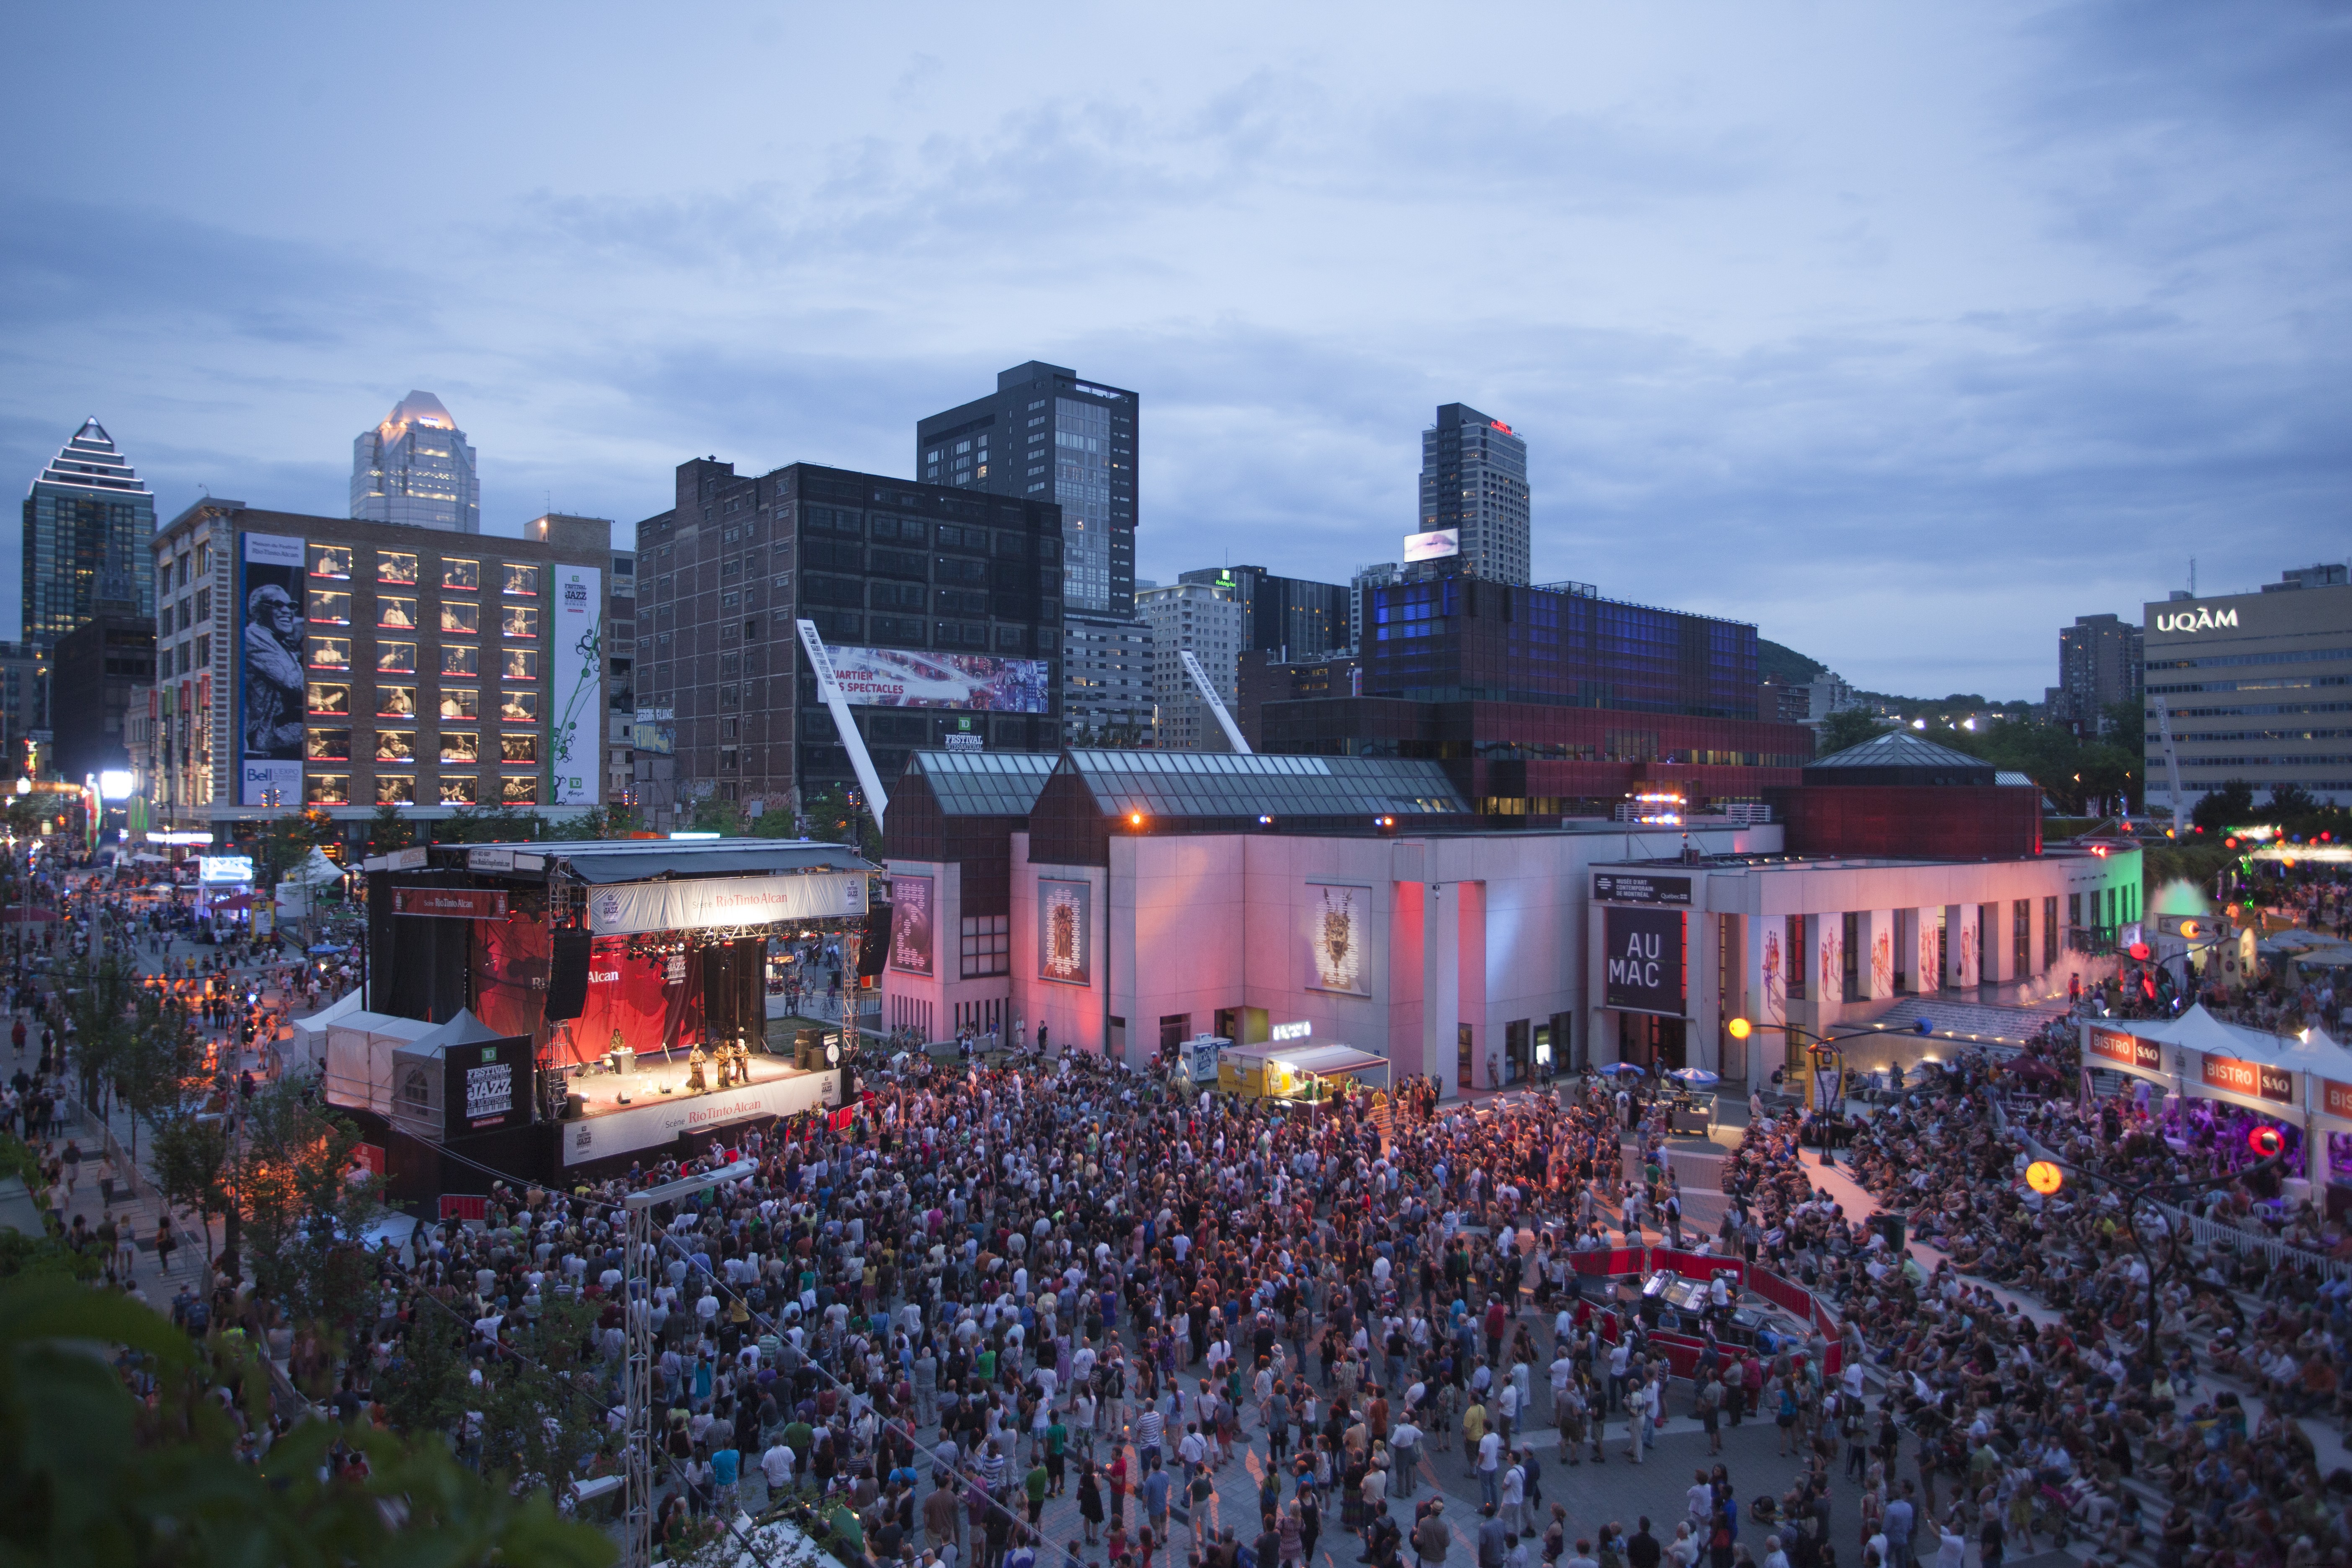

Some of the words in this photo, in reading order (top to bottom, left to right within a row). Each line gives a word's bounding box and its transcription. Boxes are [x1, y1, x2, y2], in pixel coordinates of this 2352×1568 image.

[1216, 579, 1230, 588] Holiday
[565, 591, 587, 600] JAZZ
[2157, 607, 2238, 632] UQÀM
[833, 670, 865, 681] UARTIER
[847, 682, 904, 694] SPECTACLES
[959, 719, 970, 729] TD
[945, 734, 983, 744] FESTIVAL
[248, 769, 271, 781] Bell
[570, 778, 582, 788] TD
[760, 892, 788, 904] Alcan
[1627, 932, 1660, 959] AU
[668, 962, 686, 971] JAZZ
[588, 971, 619, 983] Alcan
[1609, 958, 1659, 988] MAC
[2094, 1034, 2130, 1055] BISTRO
[483, 1049, 496, 1060] TD
[467, 1063, 512, 1079] FESTIVAL
[467, 1071, 512, 1085] INTERNATIONAL
[2207, 1062, 2252, 1085] BISTRO
[2262, 1075, 2289, 1093] SAQ
[467, 1078, 512, 1101] JAZZ
[665, 1119, 685, 1128] Scène
[733, 1101, 761, 1114] Alcan
[577, 1137, 591, 1145] JAZZ
